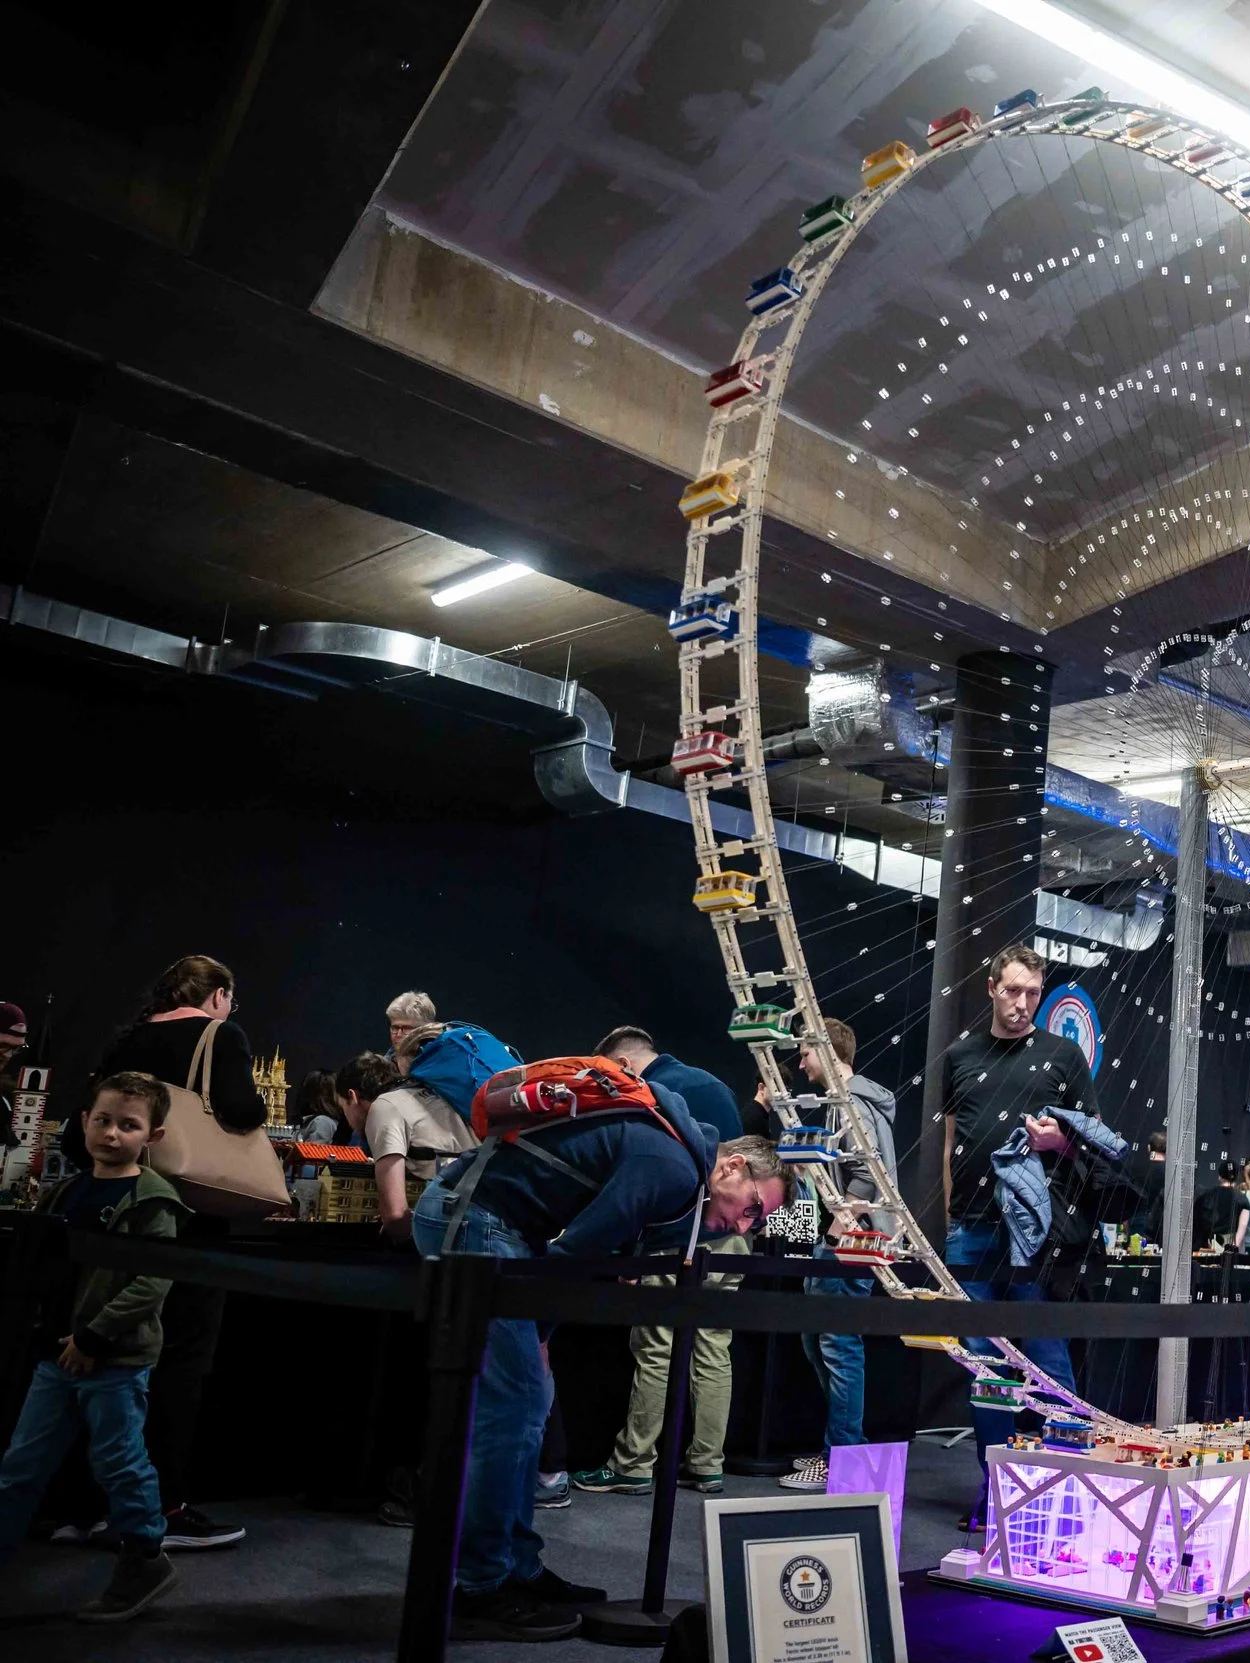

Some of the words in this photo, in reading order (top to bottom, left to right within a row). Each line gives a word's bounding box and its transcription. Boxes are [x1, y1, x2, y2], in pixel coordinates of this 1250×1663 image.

[786, 1559, 824, 1576] GUINNESS
[783, 1582, 803, 1609] WORLD
[804, 1579, 829, 1610] RECORDS
[783, 1616, 835, 1628] CERTIFICATE
